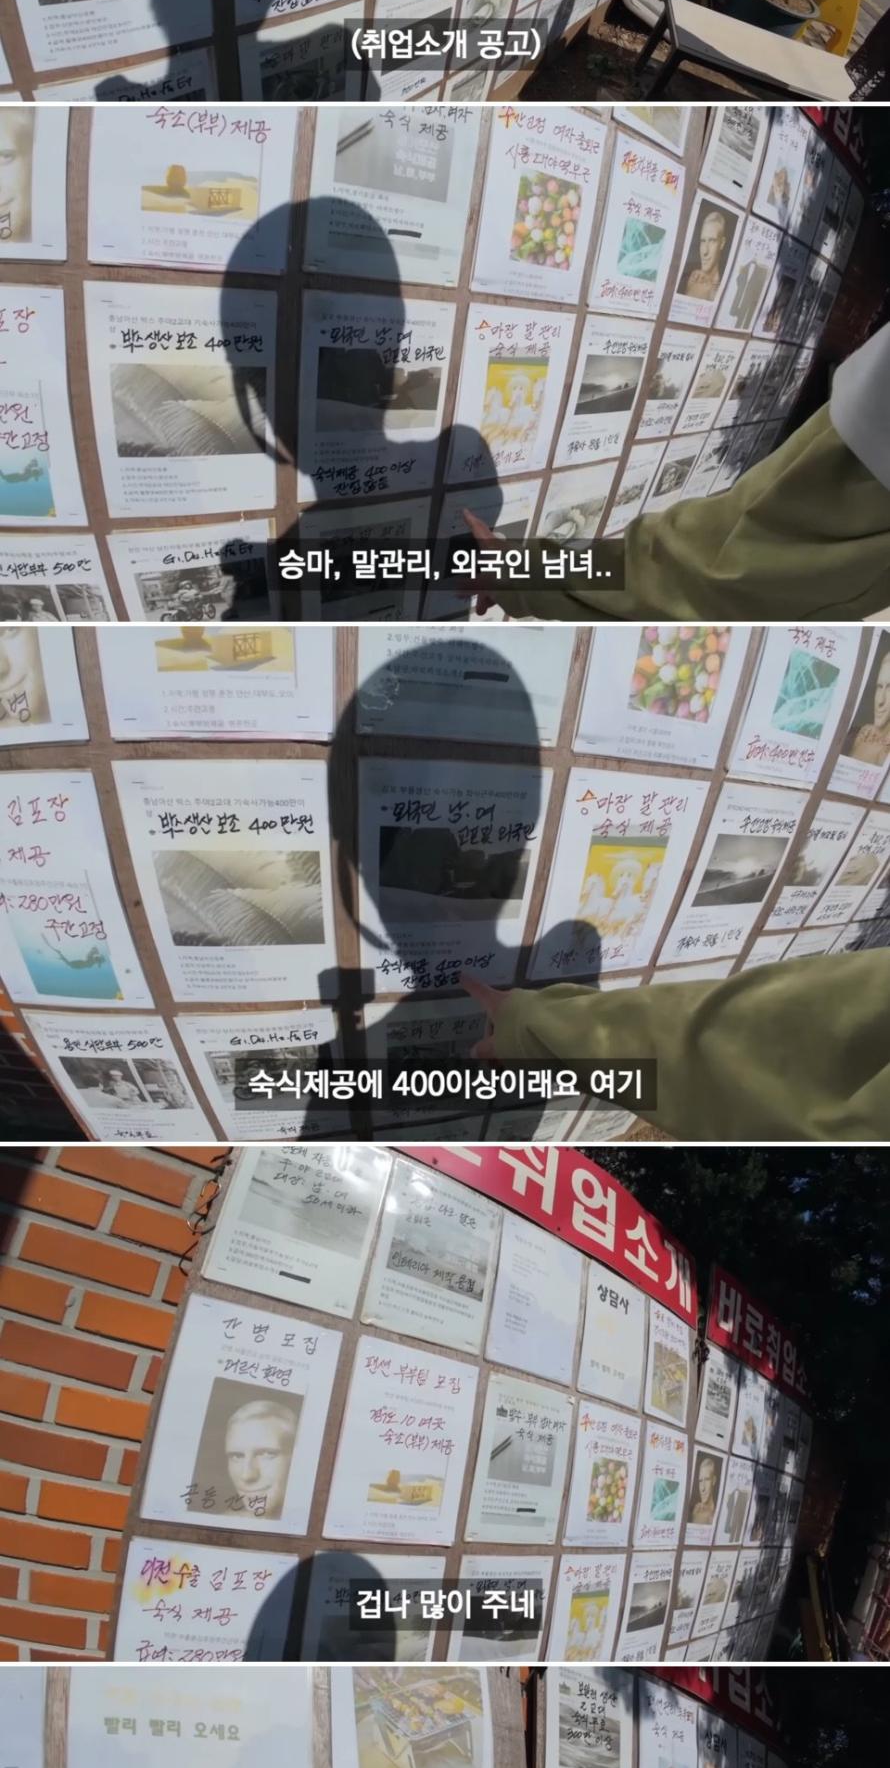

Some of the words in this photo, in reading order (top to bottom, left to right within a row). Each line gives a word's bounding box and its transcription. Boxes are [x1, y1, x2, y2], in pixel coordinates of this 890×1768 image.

[231, 119, 271, 144] 제공
[577, 788, 632, 816] 승마장
[639, 791, 658, 815] 말
[660, 795, 690, 814] 관리
[249, 813, 315, 835] 400만원
[8, 845, 50, 868] 제공
[18, 892, 87, 915] 280만원
[597, 1283, 630, 1315] 상담사
[104, 1717, 137, 1736] 빨리
[149, 1718, 181, 1737] 빨리
[194, 1722, 241, 1742] 오세요
